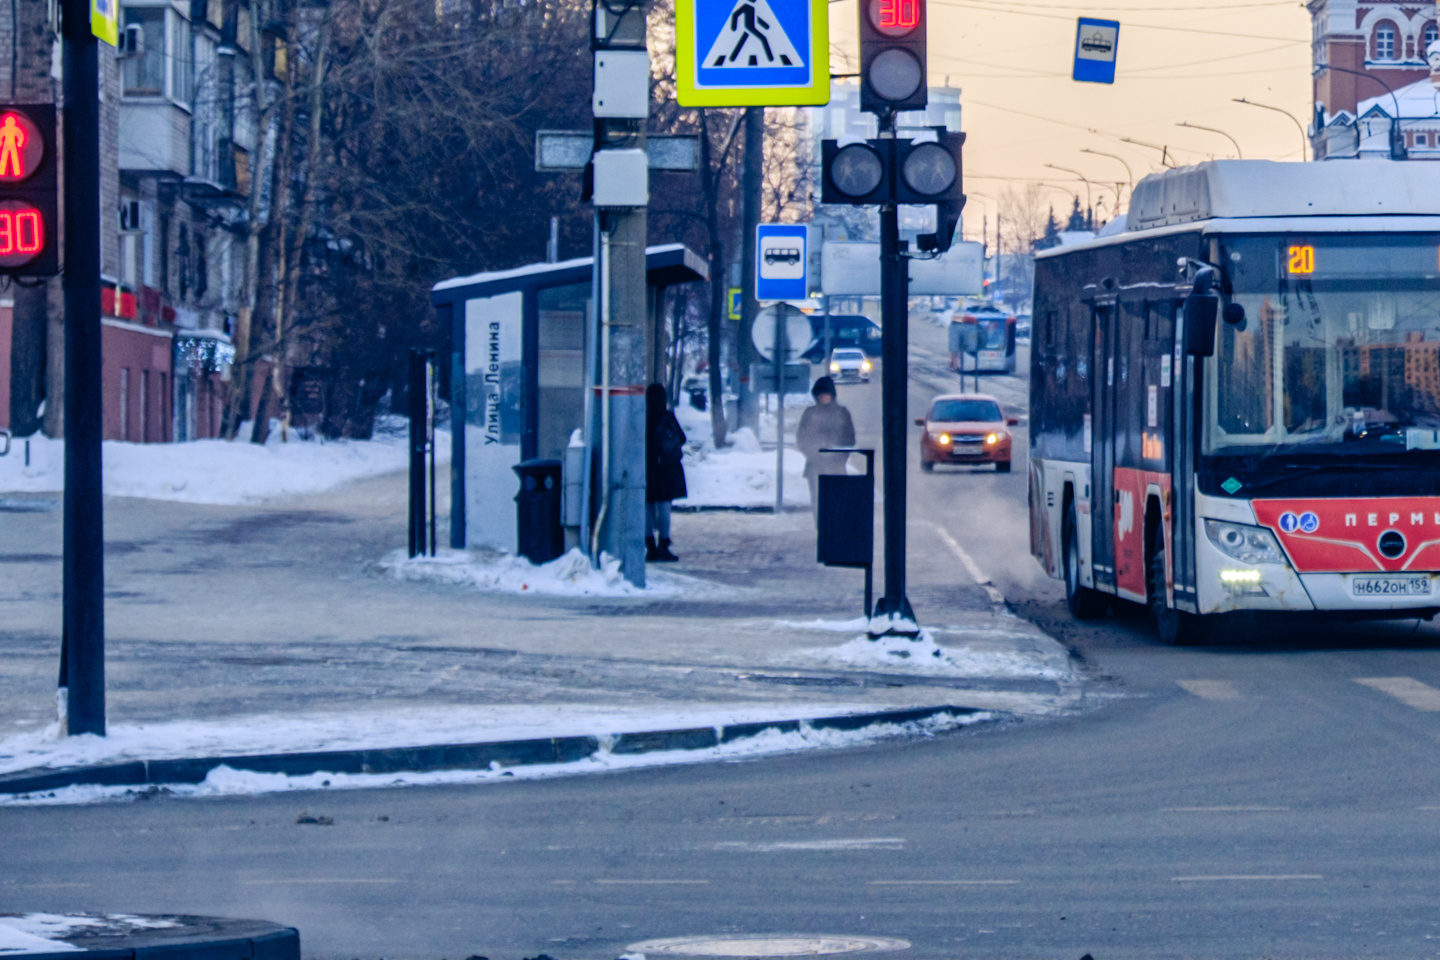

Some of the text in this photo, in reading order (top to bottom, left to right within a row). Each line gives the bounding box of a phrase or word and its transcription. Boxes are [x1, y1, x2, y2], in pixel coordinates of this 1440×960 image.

[1288, 245, 1314, 274] 20
[484, 322, 500, 445] Улица Ленина
[1410, 579, 1428, 590] 159
